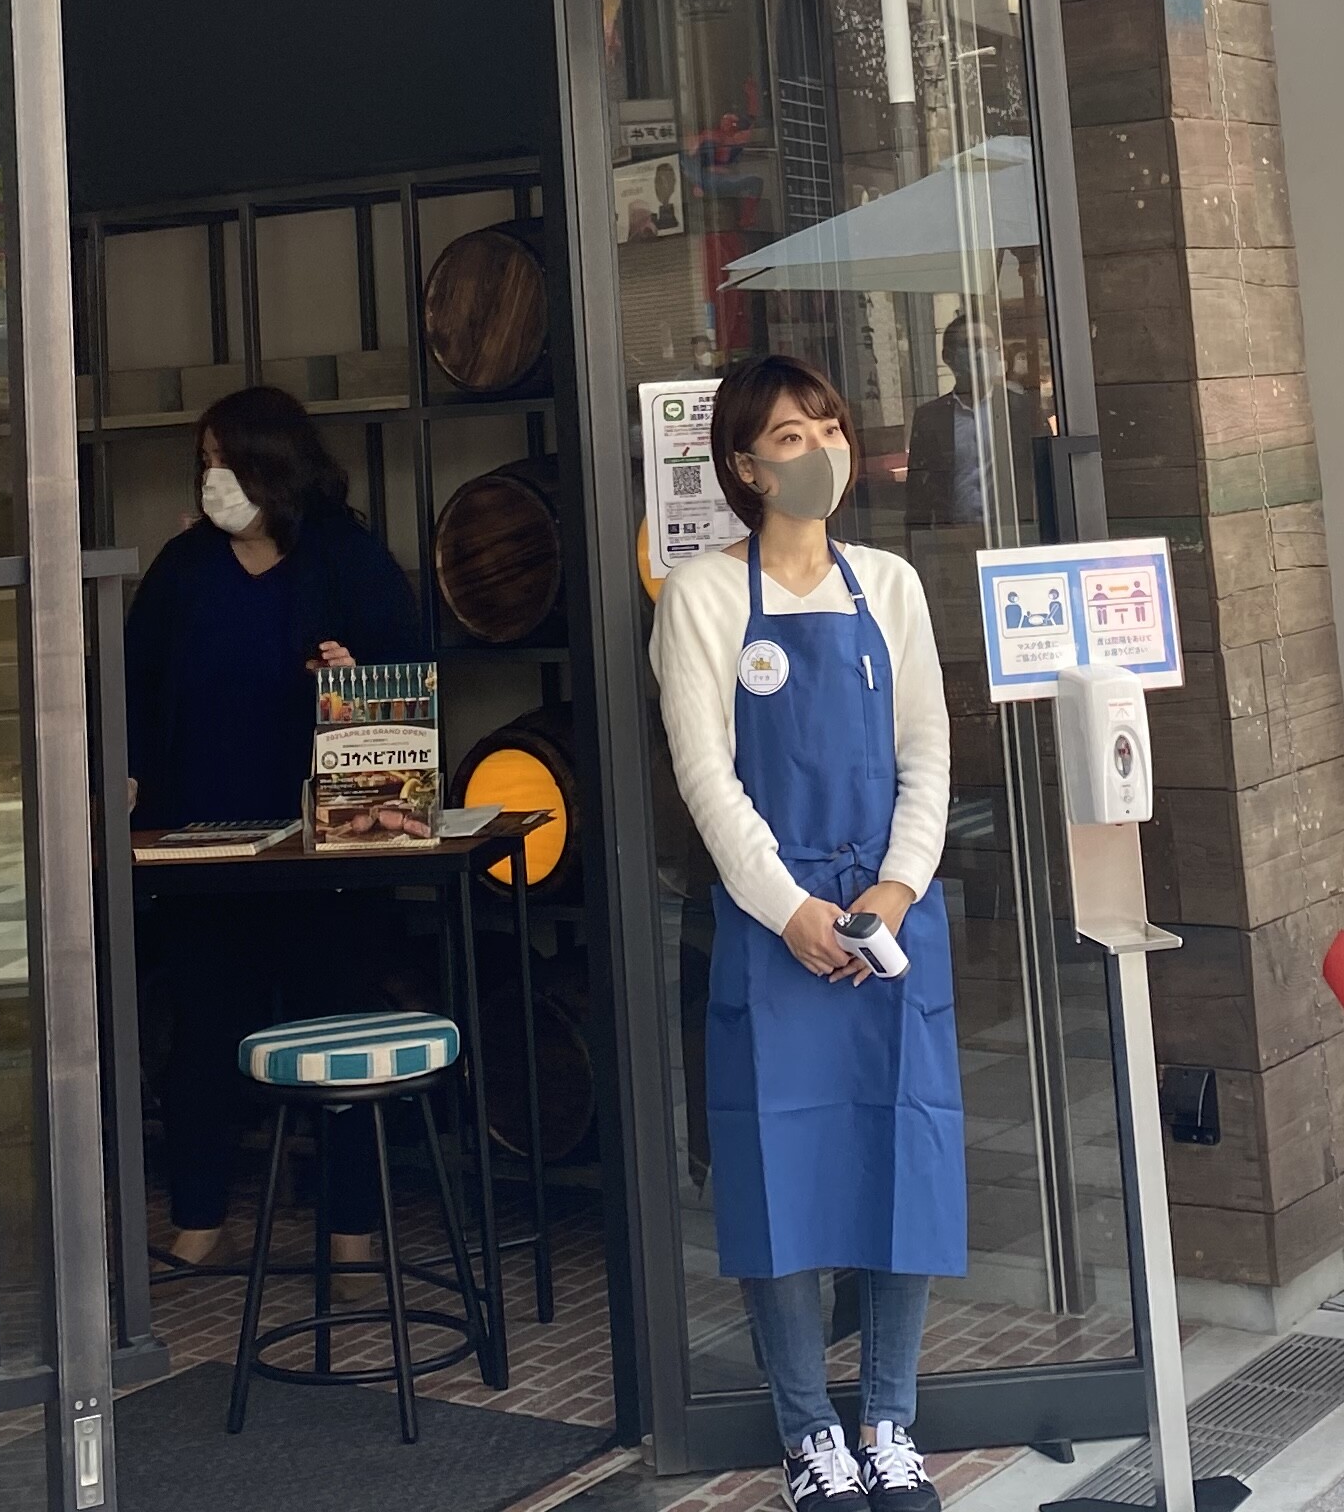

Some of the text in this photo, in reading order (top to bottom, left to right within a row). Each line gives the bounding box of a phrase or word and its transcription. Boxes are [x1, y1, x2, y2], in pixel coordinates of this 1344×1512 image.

[372, 728, 401, 736] GRAND
[340, 748, 432, 767] コウベビアハウゼ
